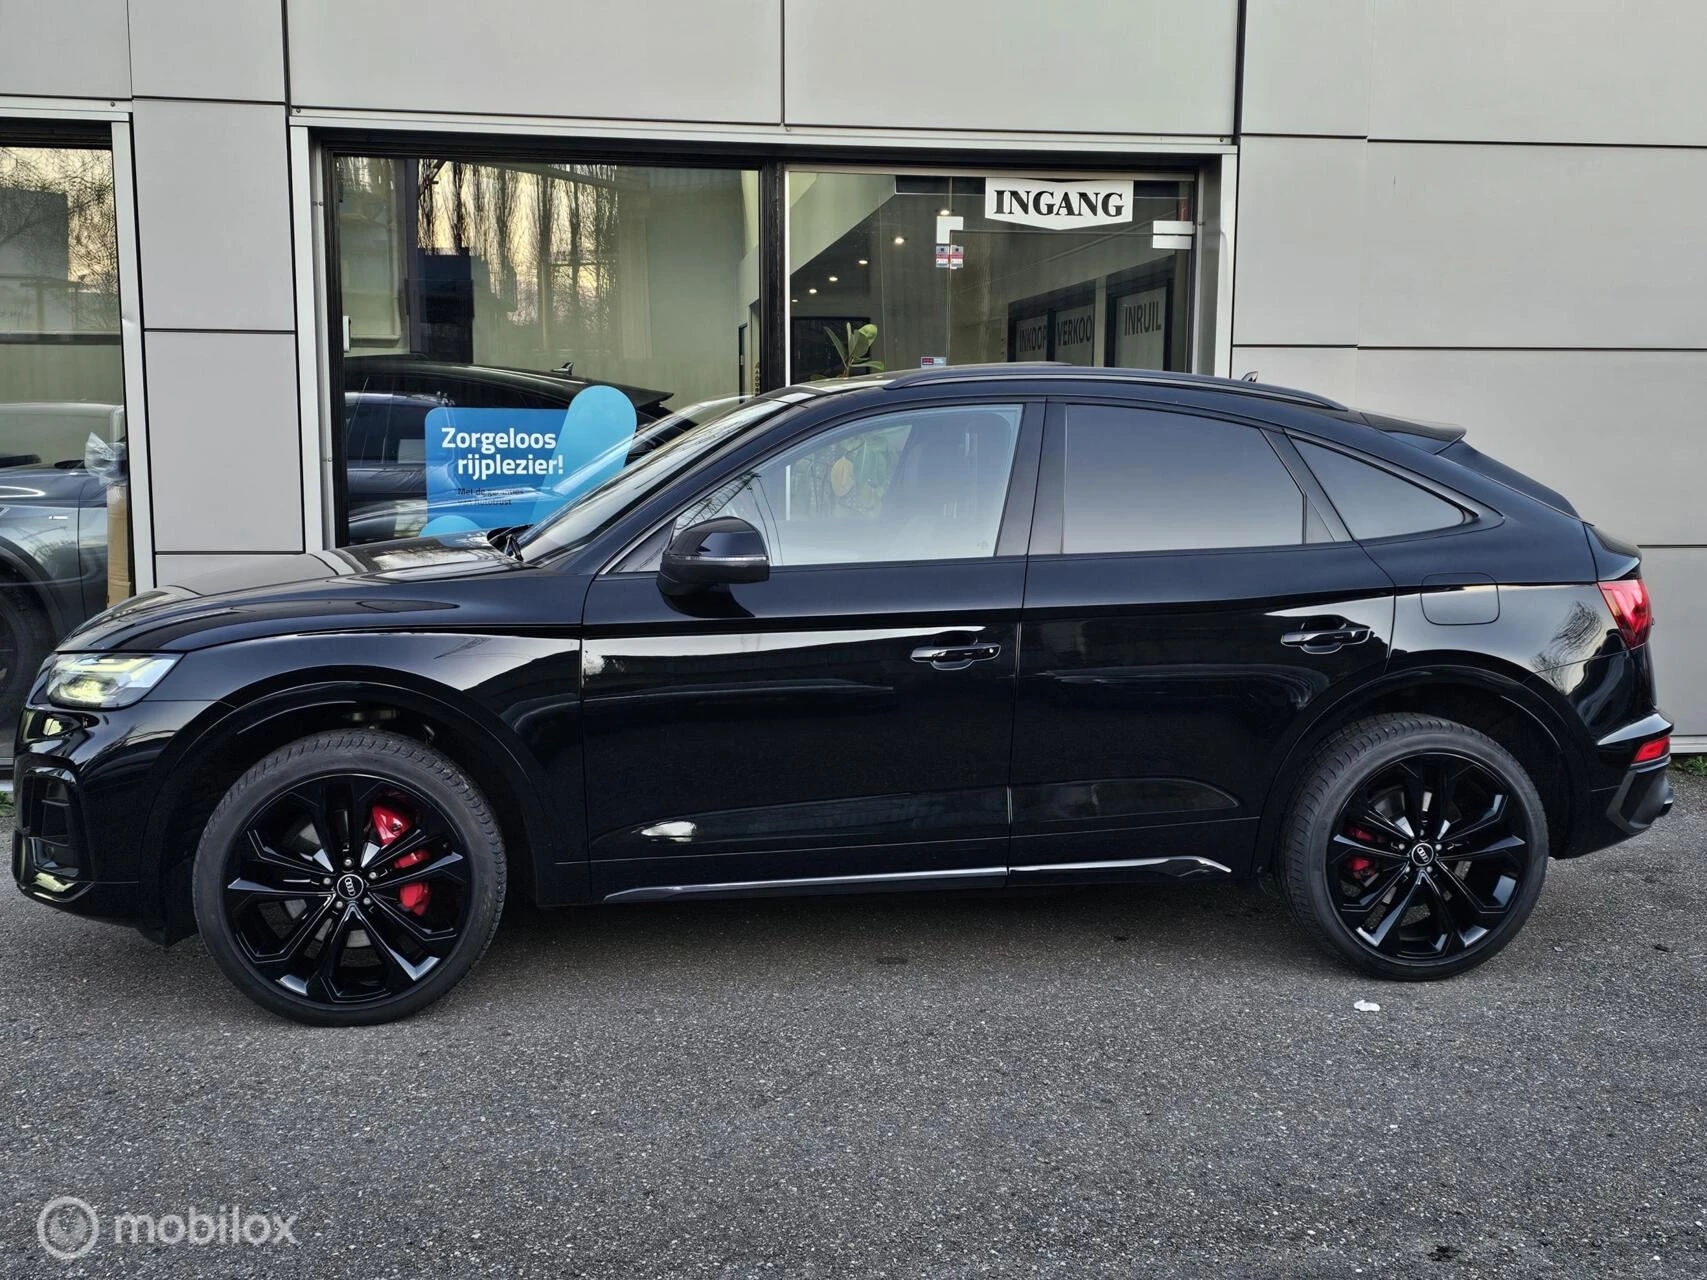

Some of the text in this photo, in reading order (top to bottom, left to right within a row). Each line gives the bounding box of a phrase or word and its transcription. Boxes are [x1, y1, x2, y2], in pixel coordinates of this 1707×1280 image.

[993, 189, 1125, 218] INGANG
[1124, 300, 1162, 337] INRUIL
[441, 427, 557, 454] Zorgeloos
[457, 454, 564, 481] rijplezier!
